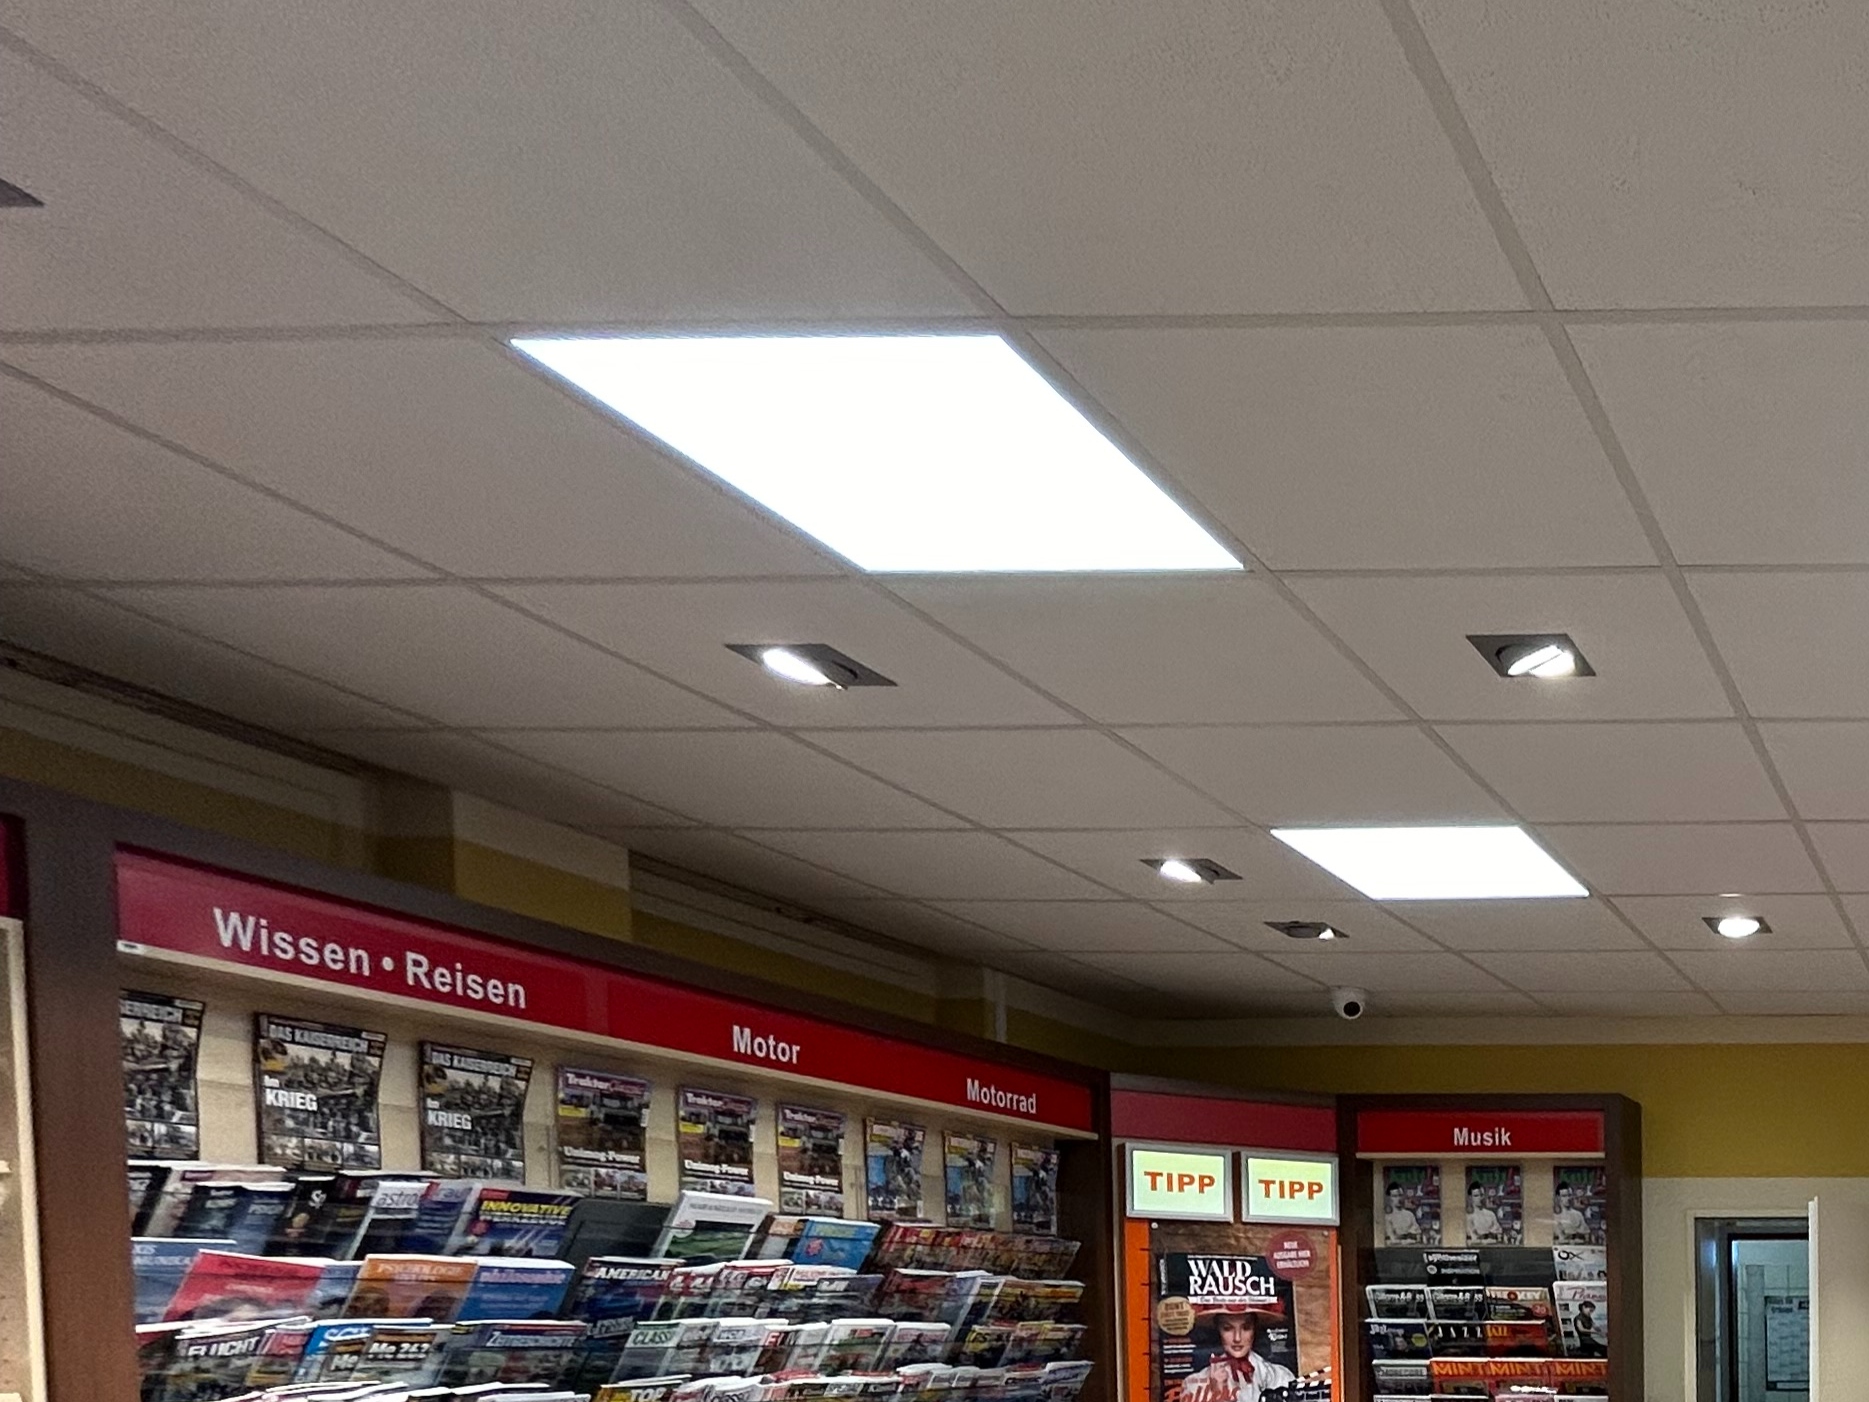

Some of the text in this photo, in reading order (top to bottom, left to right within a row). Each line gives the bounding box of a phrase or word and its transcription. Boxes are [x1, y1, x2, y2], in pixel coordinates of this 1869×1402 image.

[212, 908, 527, 1011] Wissen Reisen
[732, 1023, 801, 1066] Motor
[266, 1088, 317, 1111] KRIEG
[965, 1076, 1038, 1115] Motorrad
[427, 1109, 471, 1130] KRIEG
[1453, 1127, 1511, 1147] Musik
[1144, 1171, 1216, 1195] TIPP
[1258, 1179, 1323, 1199] TIPP
[481, 1201, 573, 1218] INNOVATIVE
[1188, 1260, 1251, 1277] WALD
[1190, 1277, 1275, 1295] RAUSCH
[1433, 1363, 1485, 1376] MINT
[1491, 1363, 1544, 1376] MINT
[1556, 1363, 1607, 1376] MINT
